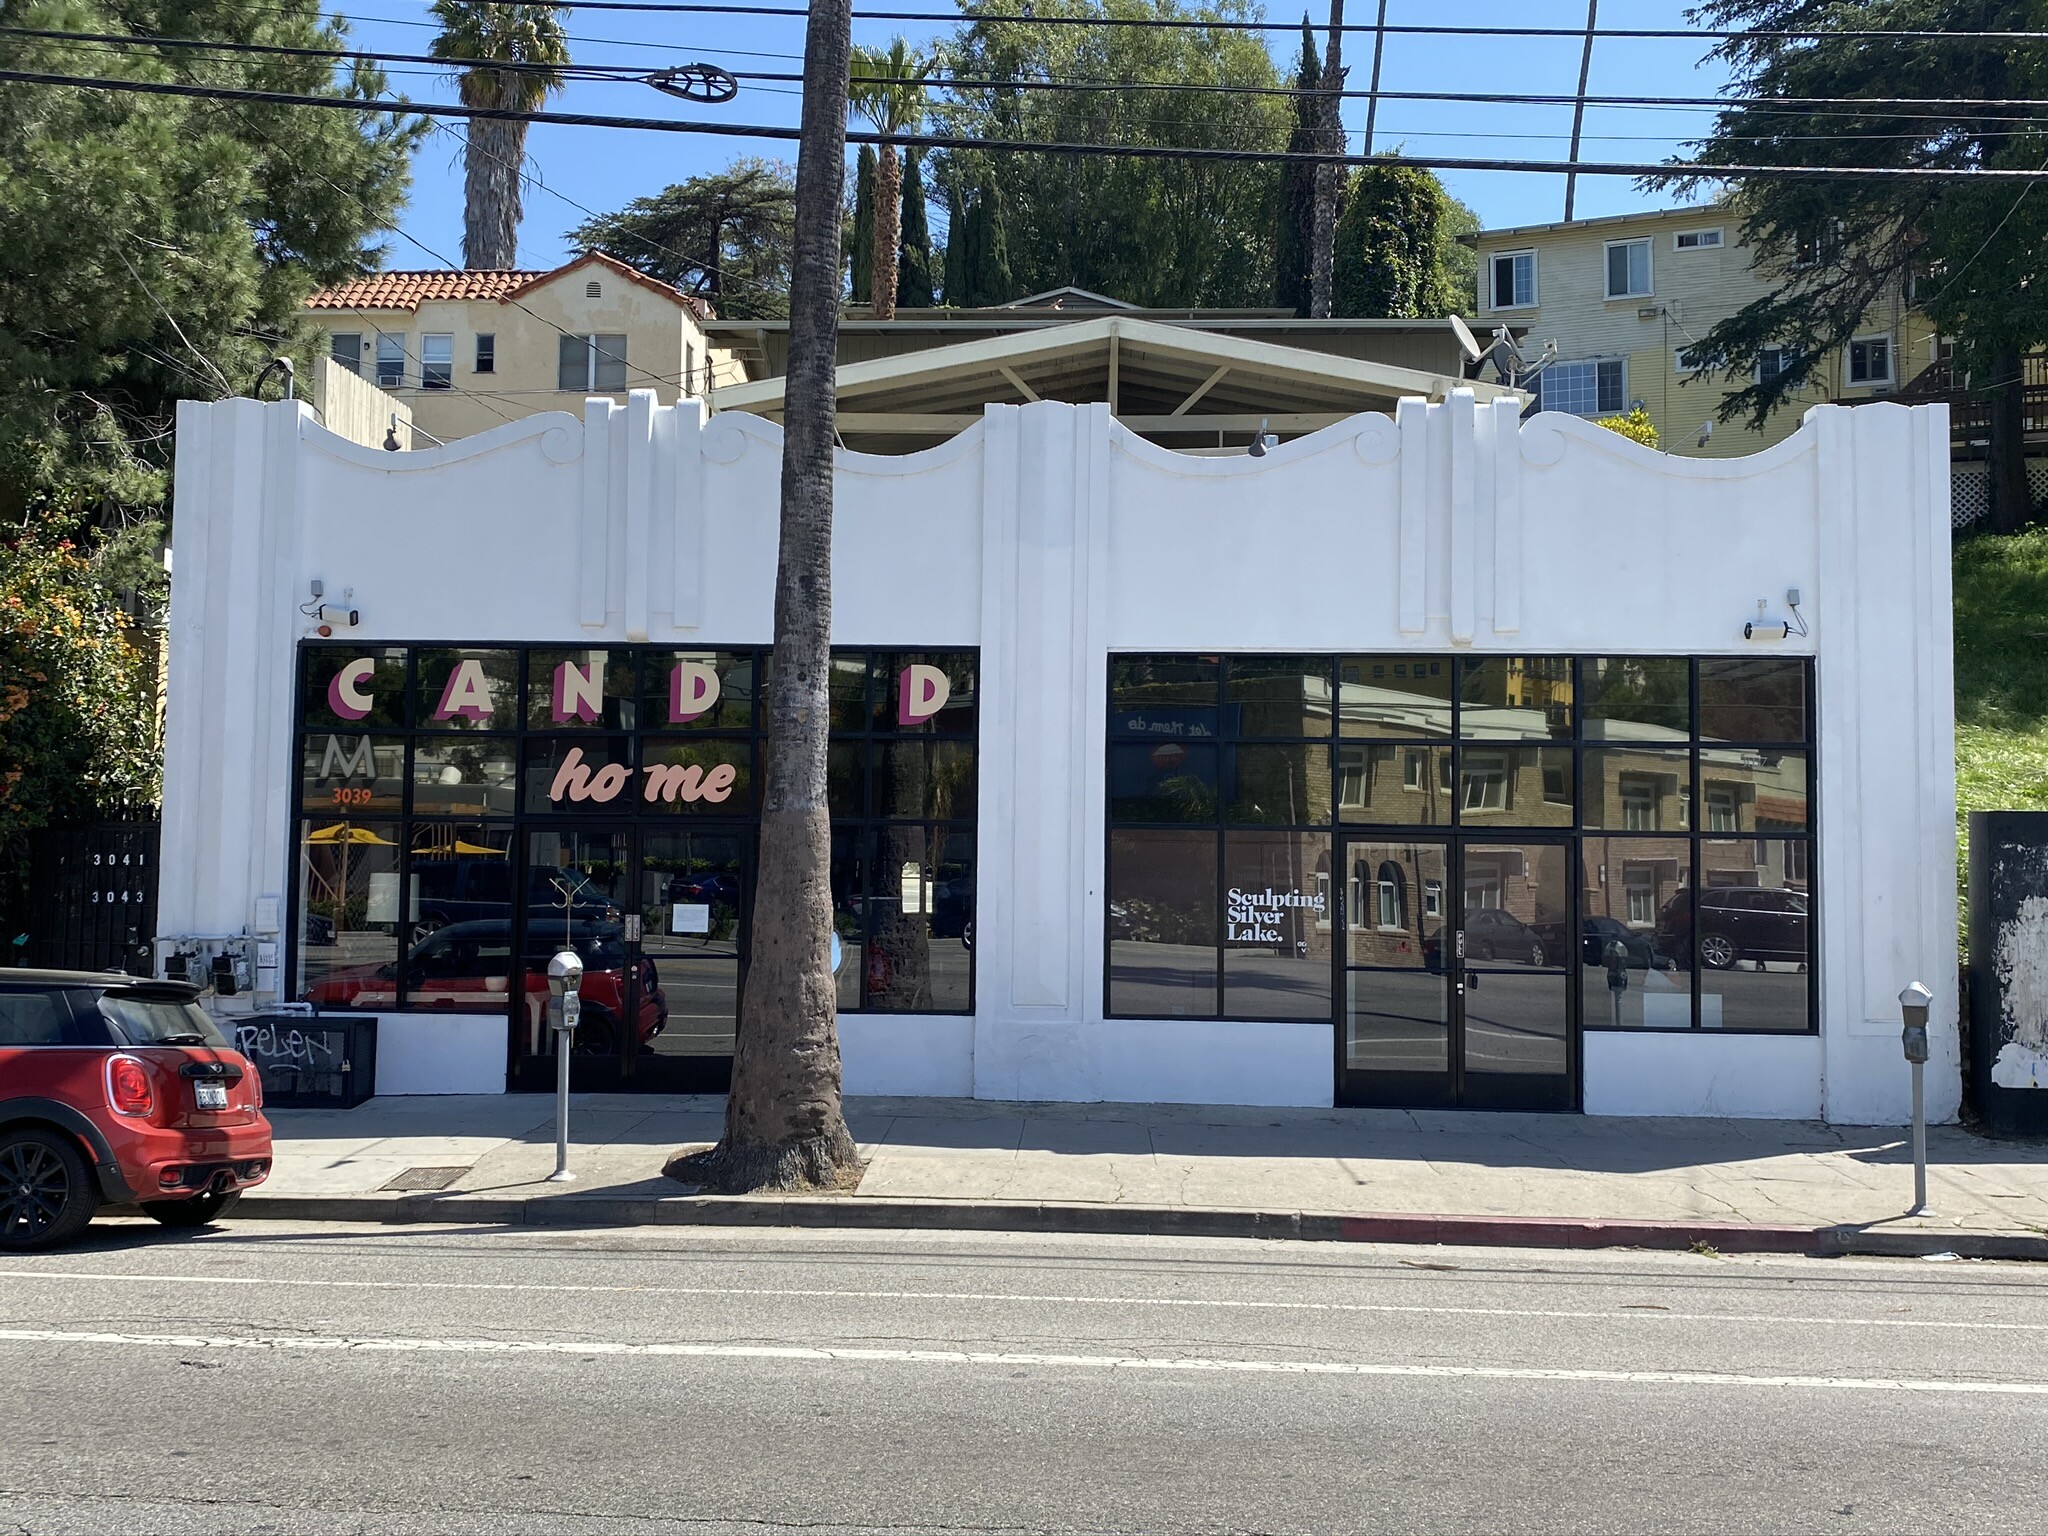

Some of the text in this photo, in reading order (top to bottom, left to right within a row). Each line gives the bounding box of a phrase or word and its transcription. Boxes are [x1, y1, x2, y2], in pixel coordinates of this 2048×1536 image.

[549, 747, 736, 803] home
[331, 787, 372, 804] 3039
[93, 854, 143, 866] 3041
[92, 891, 143, 903] 3043
[1227, 887, 1325, 912] Sculpting
[1227, 905, 1285, 924] Silver
[1227, 923, 1284, 942] Lake.
